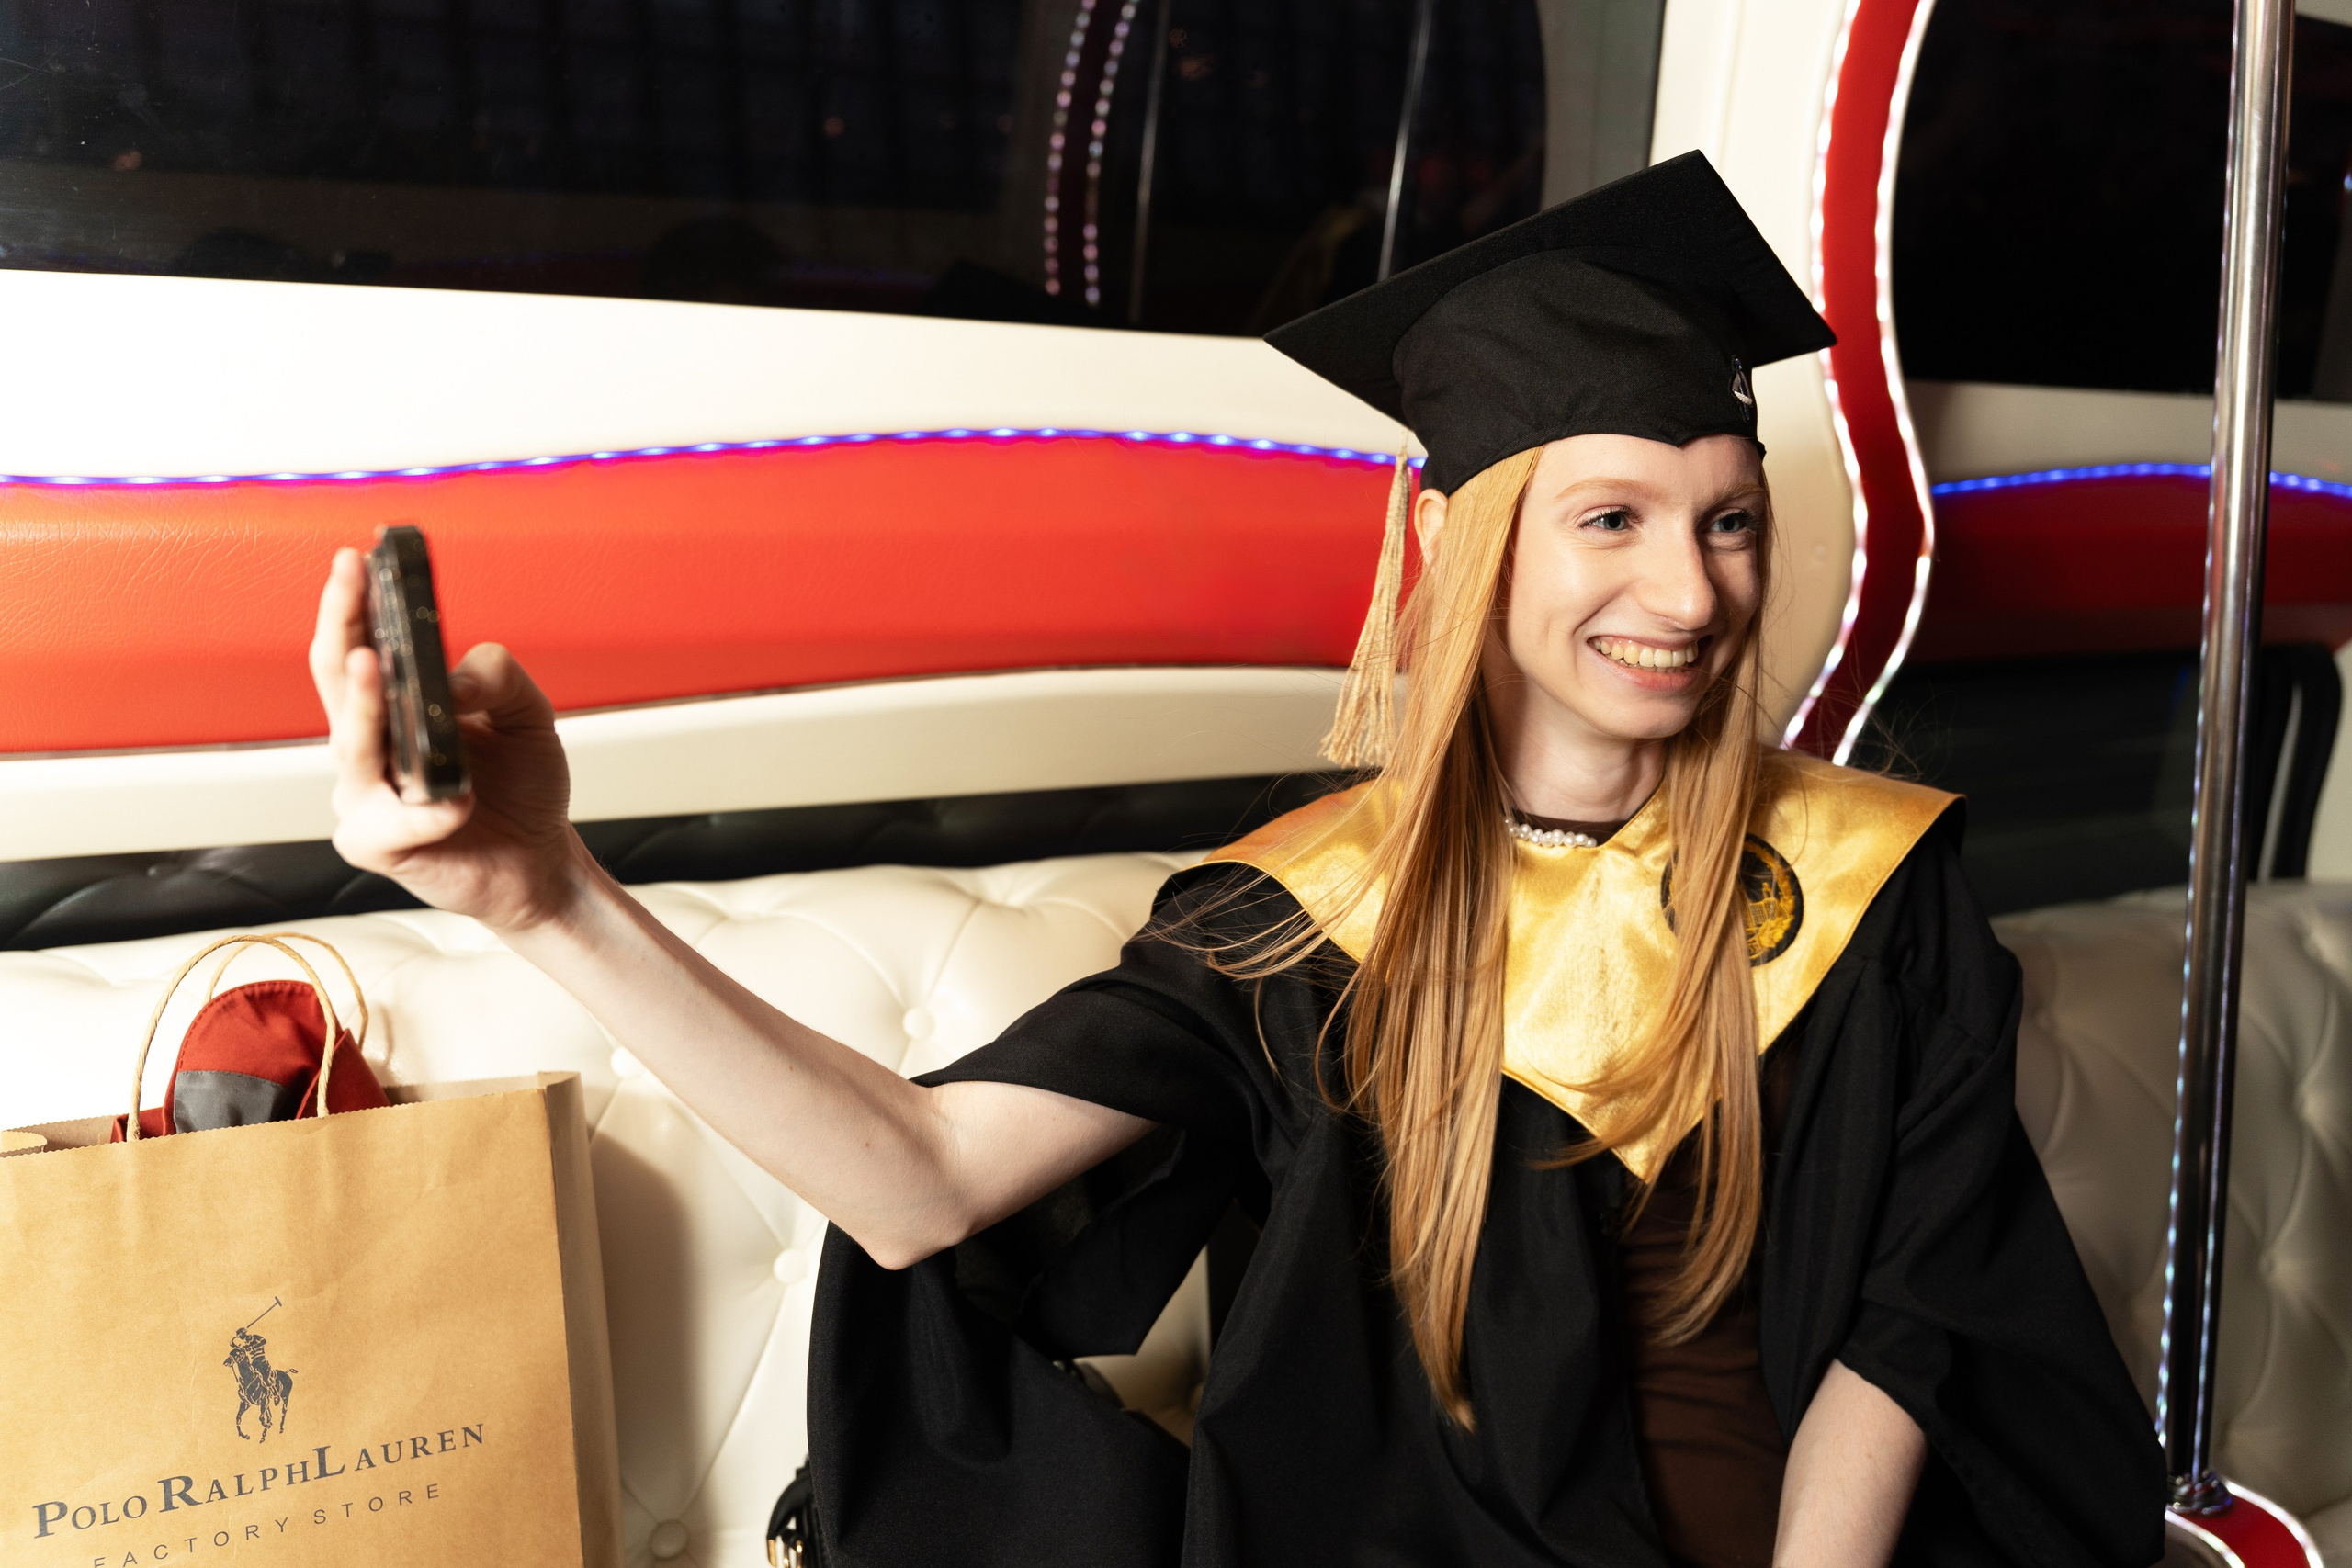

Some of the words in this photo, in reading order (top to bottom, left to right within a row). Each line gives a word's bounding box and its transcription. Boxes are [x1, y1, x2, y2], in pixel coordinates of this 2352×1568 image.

[32, 1495, 148, 1540] POLO
[156, 1460, 311, 1514] RALPH
[311, 1423, 485, 1481] LAUREN
[94, 1517, 288, 1568] FACTORY
[313, 1483, 440, 1525] STORE
